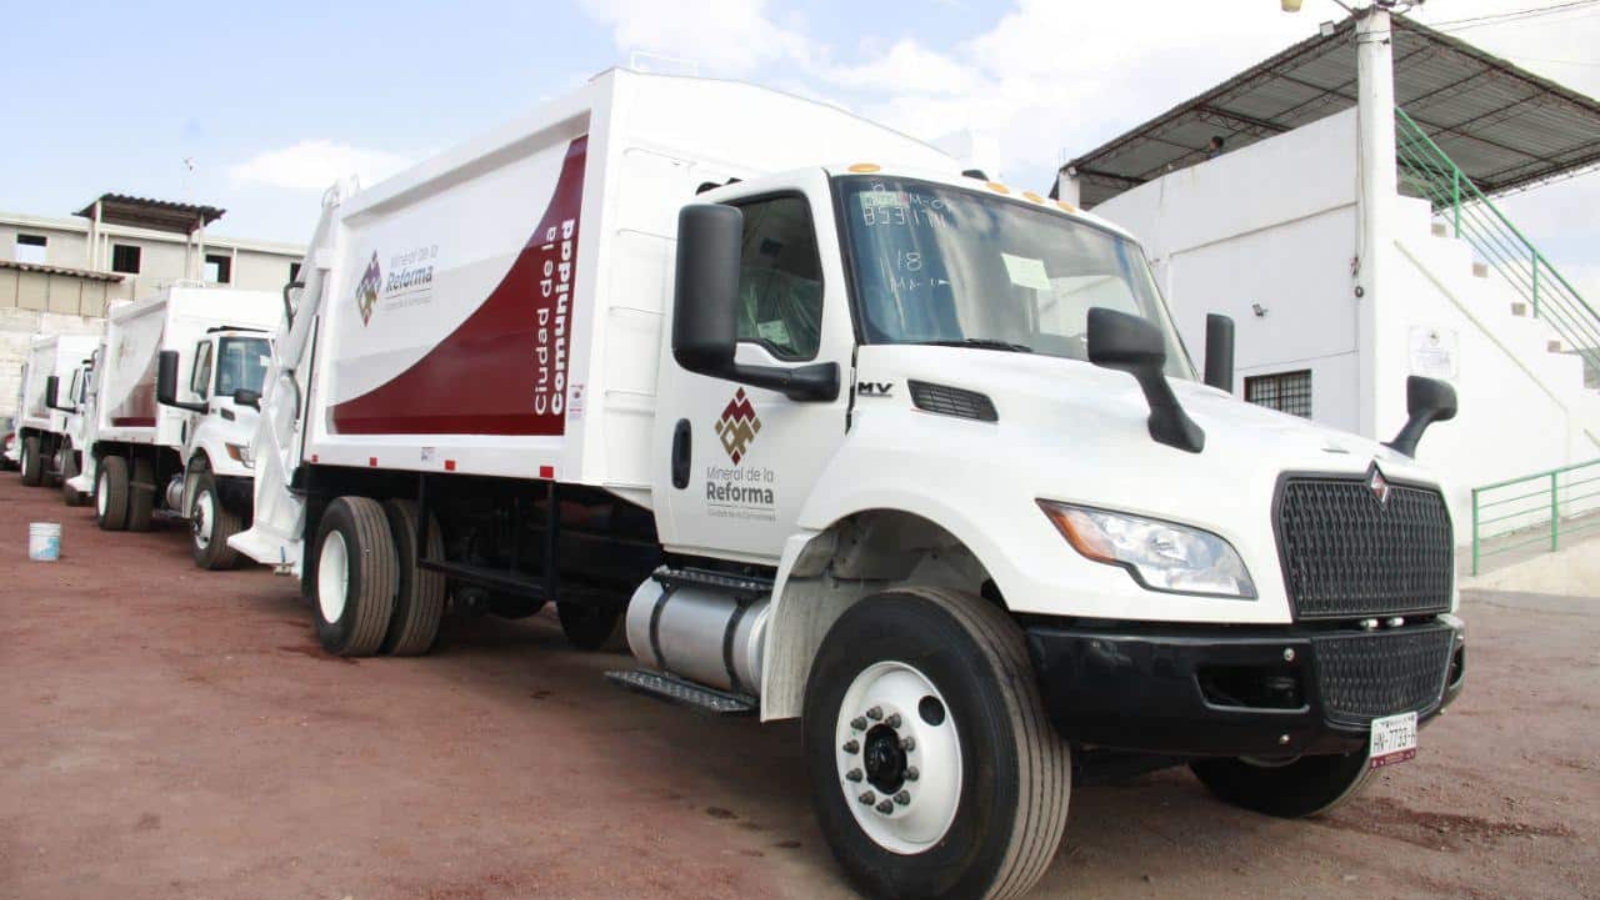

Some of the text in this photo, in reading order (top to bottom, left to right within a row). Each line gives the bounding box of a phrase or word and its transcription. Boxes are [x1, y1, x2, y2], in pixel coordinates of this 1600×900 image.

[386, 265, 434, 293] Reforma
[535, 227, 556, 415] Ciudad de la
[551, 219, 575, 415] Comunidad
[858, 381, 894, 393] MV
[706, 466, 774, 483] Mineral de la
[706, 481, 775, 504] Reforma
